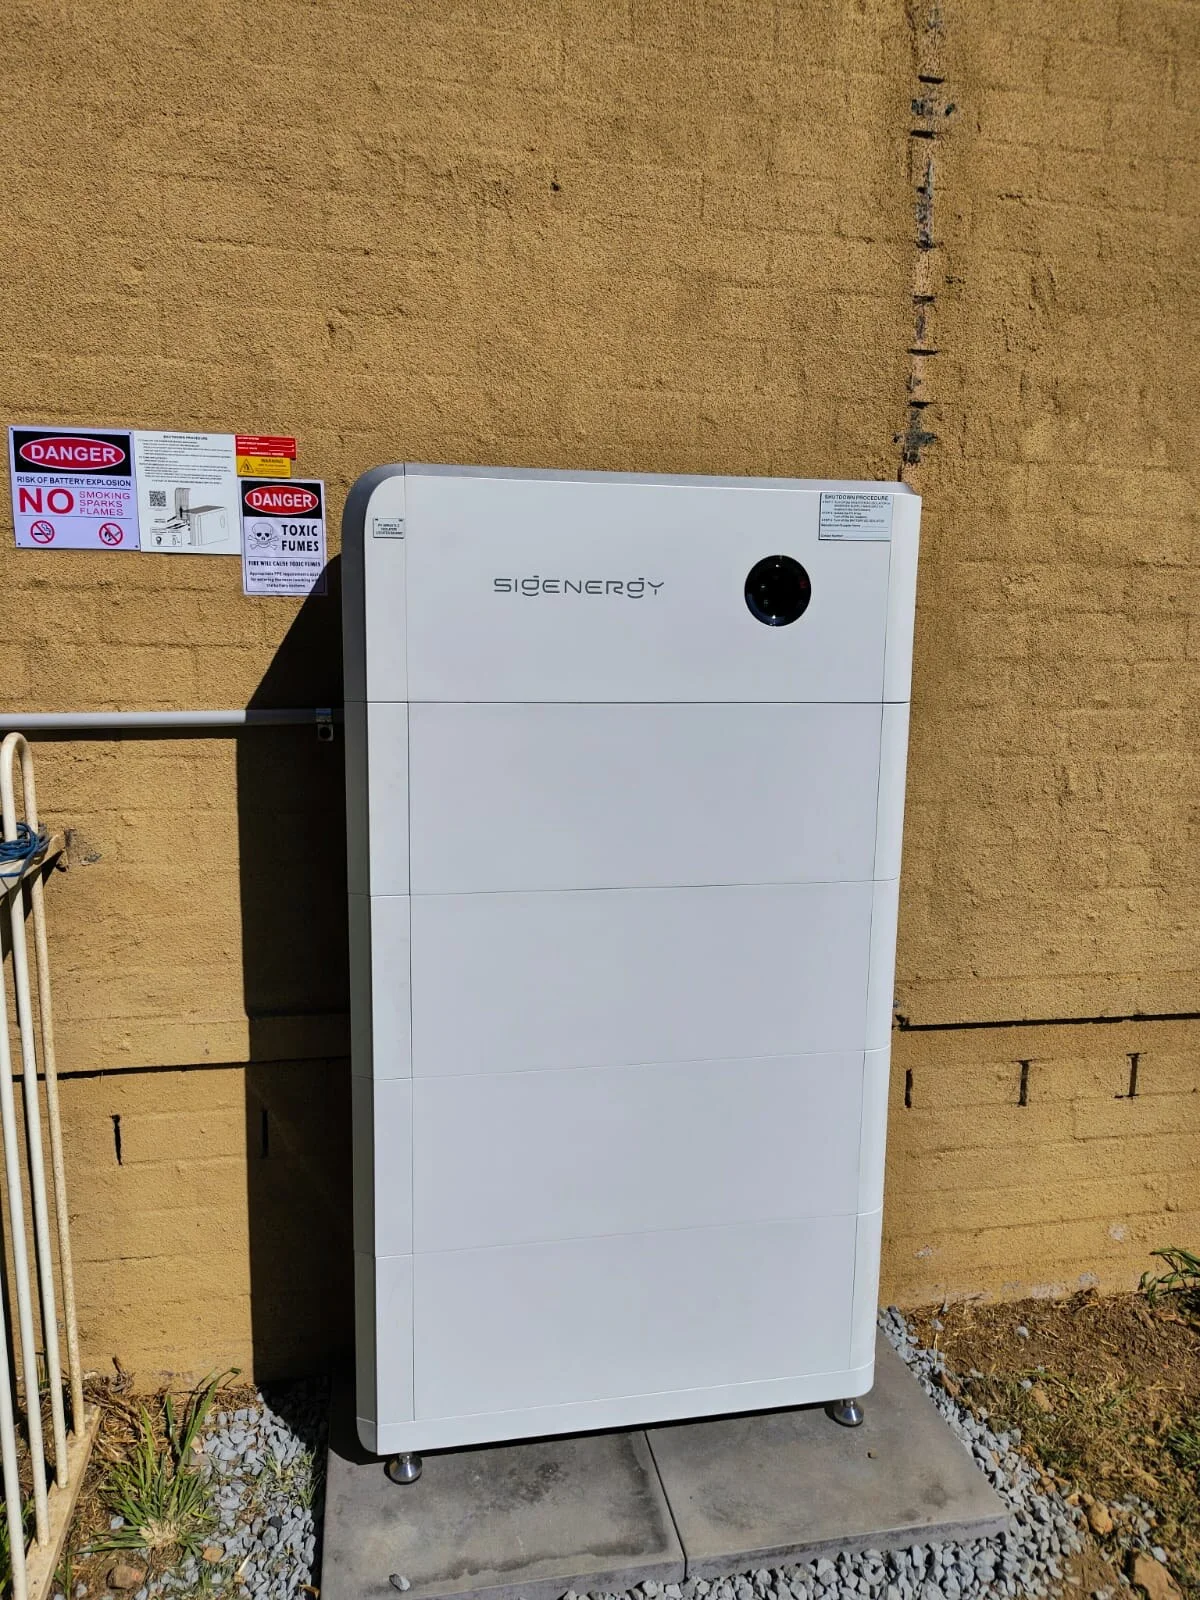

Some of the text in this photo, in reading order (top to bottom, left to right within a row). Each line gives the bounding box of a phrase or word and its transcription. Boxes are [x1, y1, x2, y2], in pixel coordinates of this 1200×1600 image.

[30, 445, 116, 462] DANGER
[38, 476, 47, 484] OF
[50, 477, 85, 485] BATTERY
[86, 478, 131, 487] EXPLOSION
[18, 487, 74, 514] NO
[79, 490, 130, 500] SMOKING
[252, 492, 313, 508] DANGER
[79, 499, 123, 508] SPARKS
[79, 507, 124, 516] FLAMES
[281, 524, 318, 537] TOXIC
[281, 540, 319, 552] FUMES
[493, 575, 665, 599] SIGENERGY
